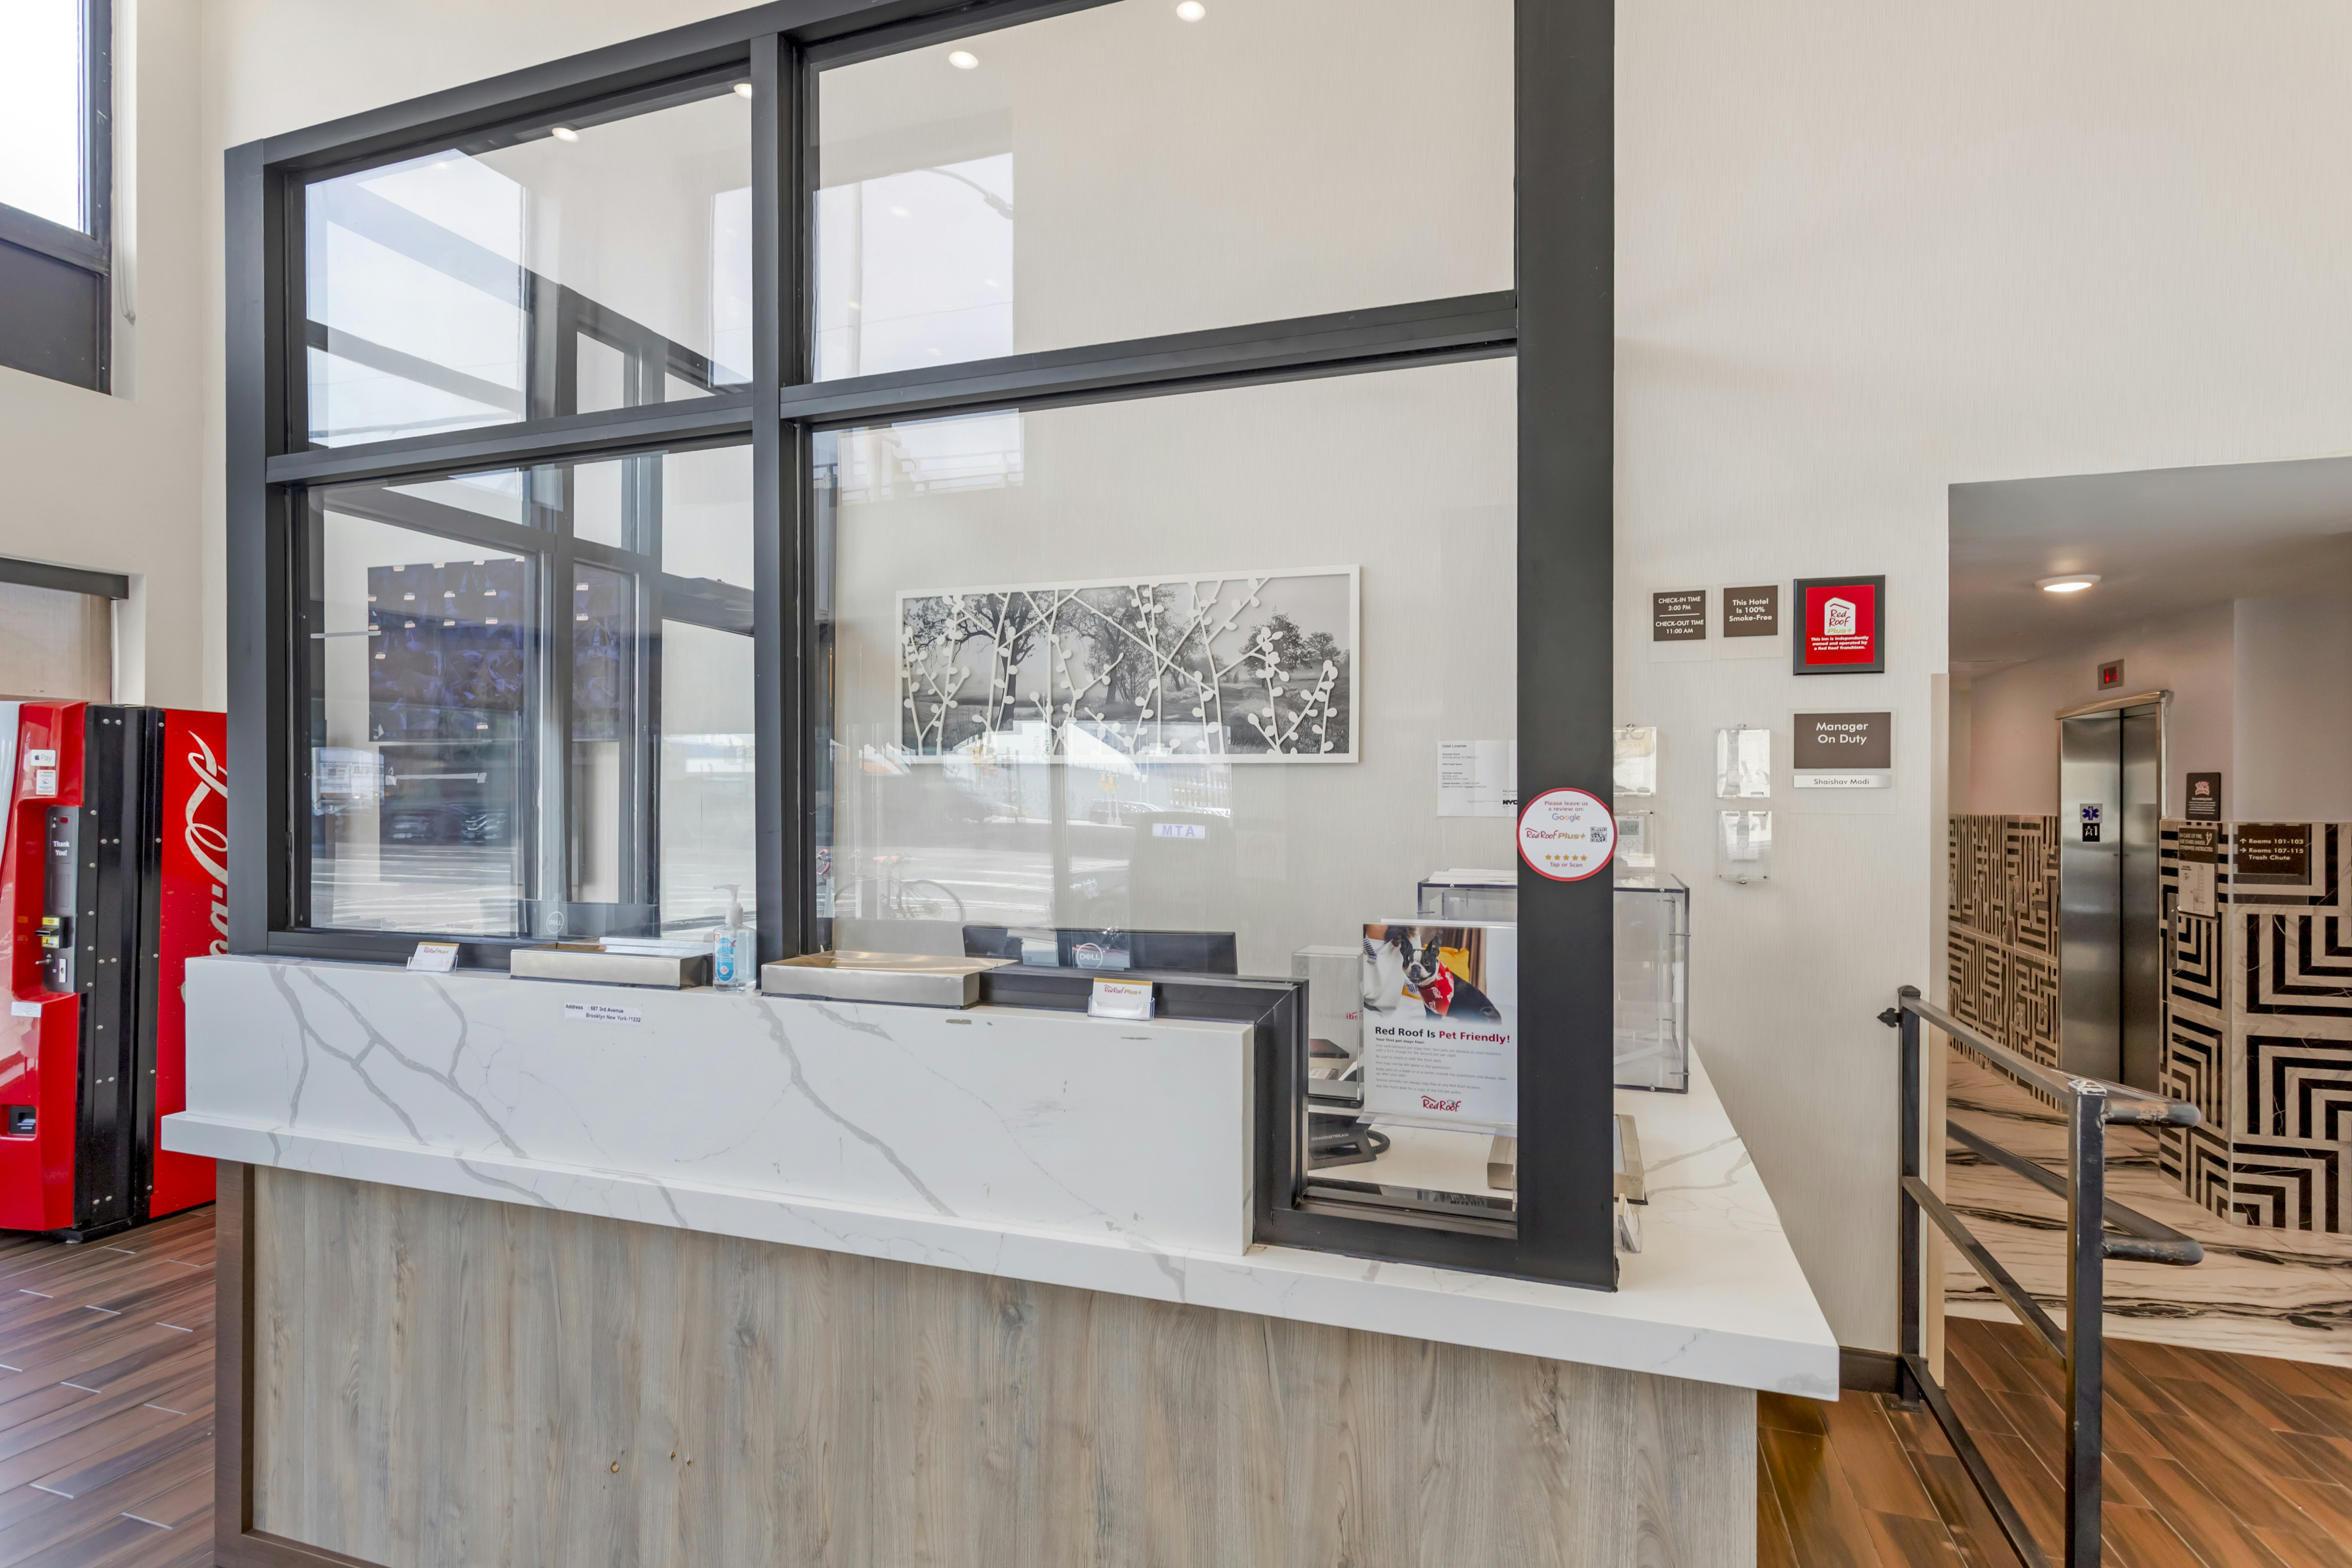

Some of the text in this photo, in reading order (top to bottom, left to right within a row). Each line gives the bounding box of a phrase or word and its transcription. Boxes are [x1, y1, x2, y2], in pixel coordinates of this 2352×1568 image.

[1831, 609, 1847, 618] Red
[1829, 616, 1851, 627] Roof
[1816, 722, 1868, 733] Manager
[1818, 734, 1867, 745] On Duty
[41, 754, 52, 763] Pay
[1552, 813, 1580, 822] Google
[1375, 1026, 1510, 1045] Red Roof Is Pet Friendly!
